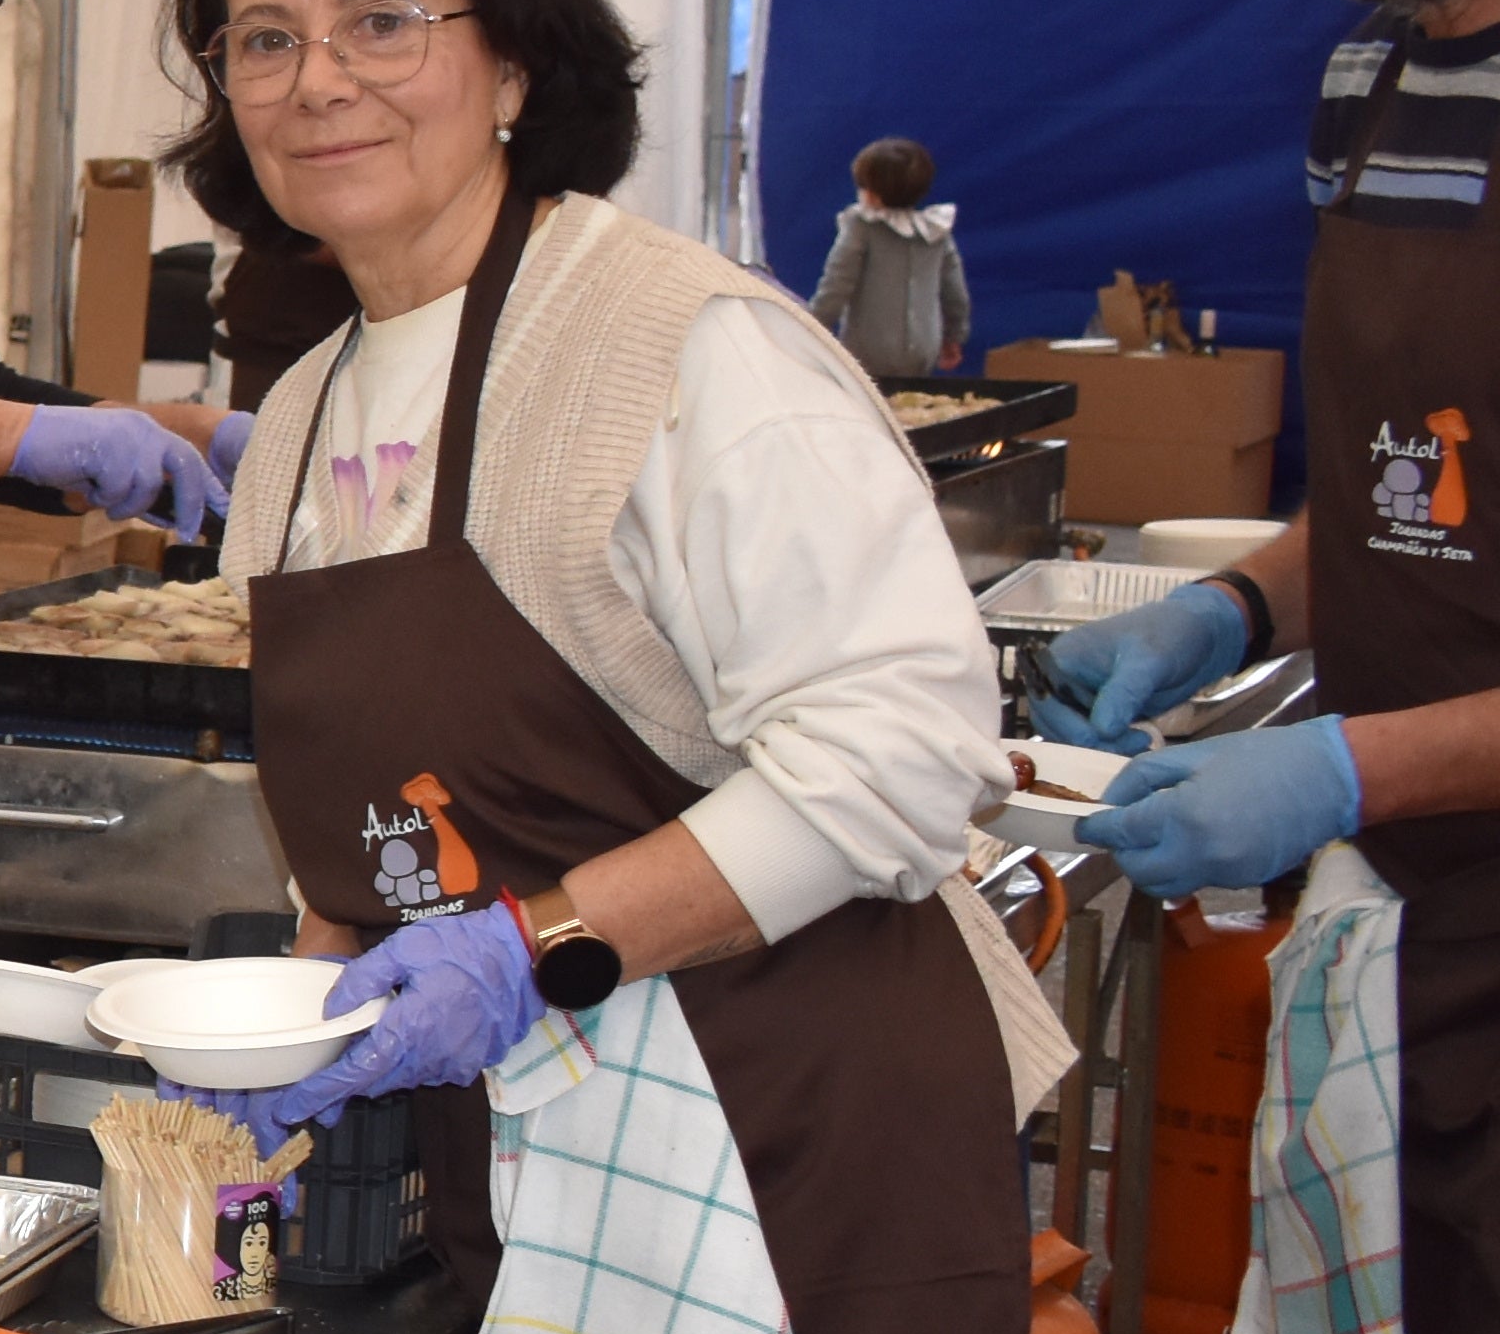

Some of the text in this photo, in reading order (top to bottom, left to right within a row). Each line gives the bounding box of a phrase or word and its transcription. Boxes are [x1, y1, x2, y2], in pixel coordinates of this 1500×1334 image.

[1369, 420, 1441, 463] Autol
[361, 802, 430, 853] Autol
[247, 1200, 268, 1215] 100
